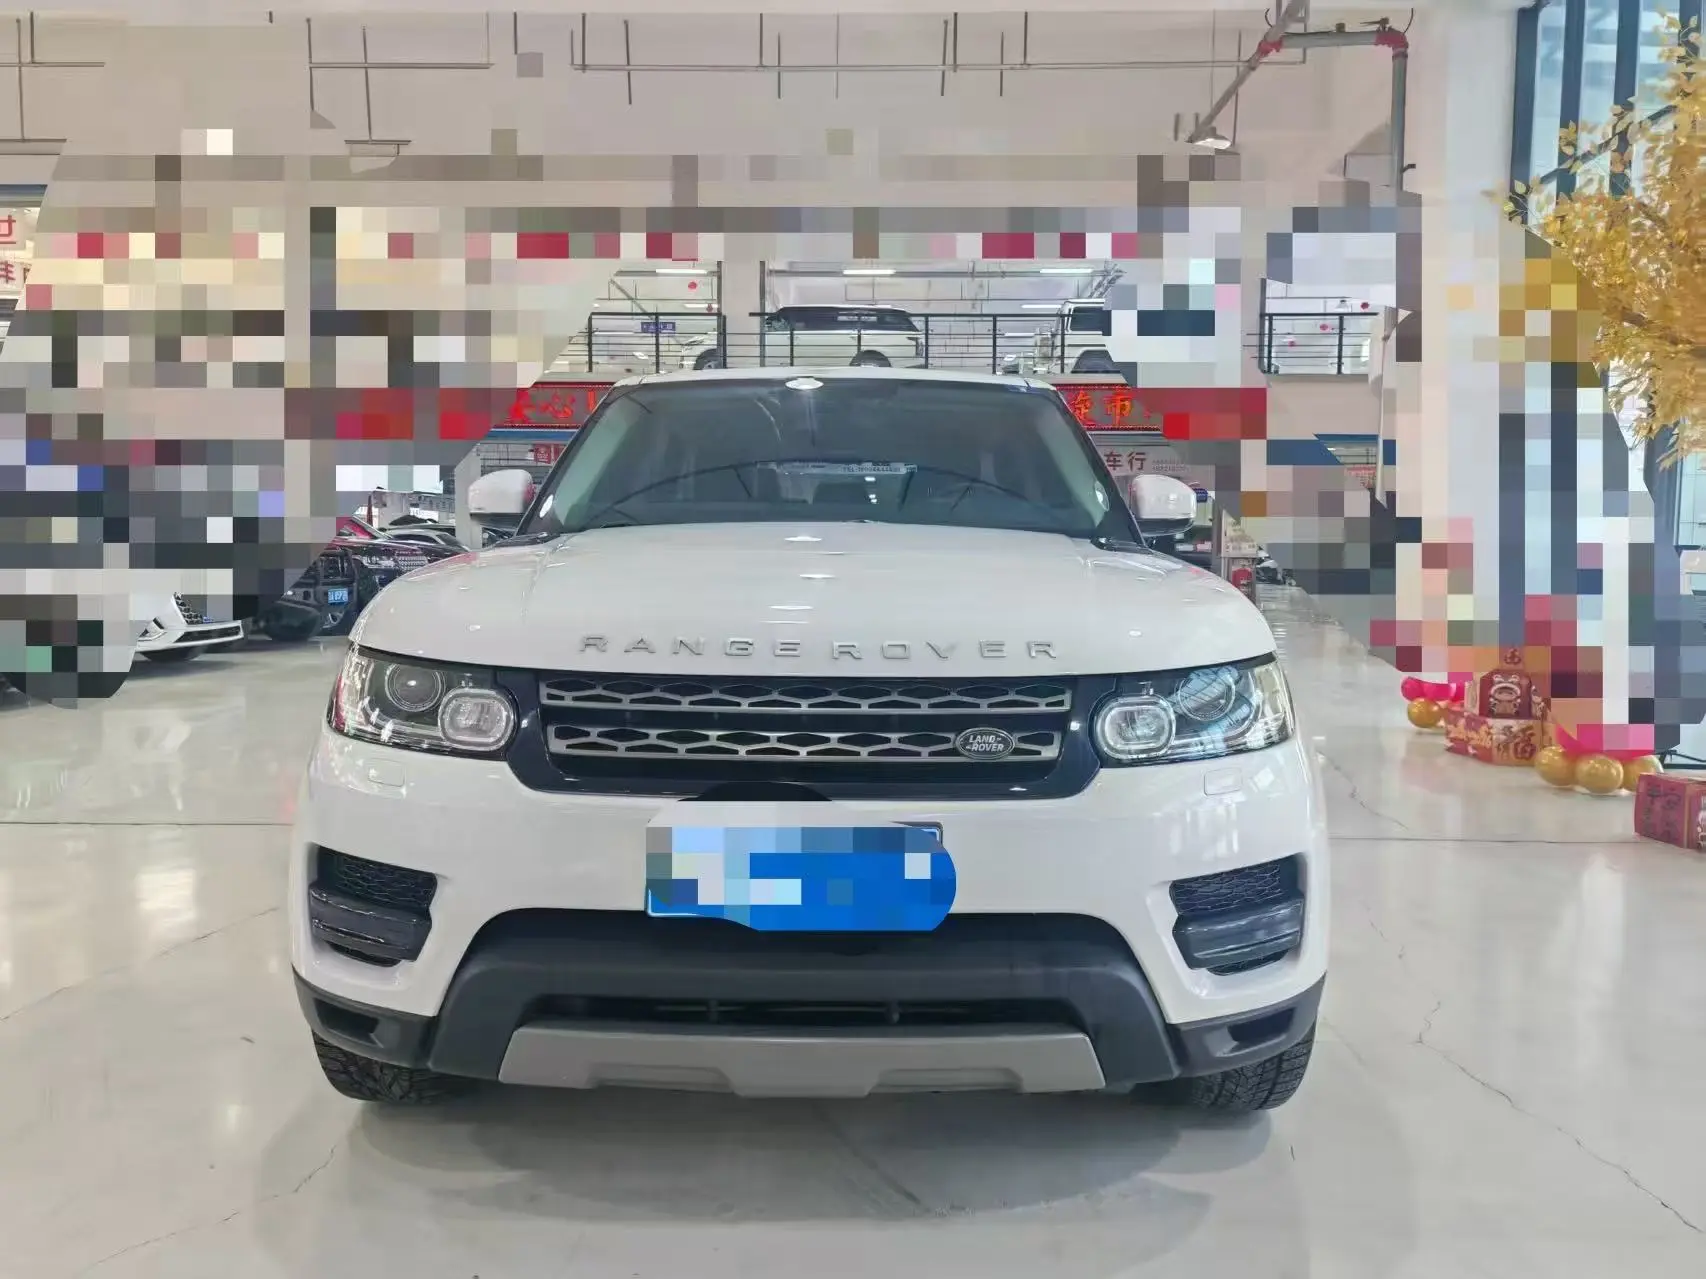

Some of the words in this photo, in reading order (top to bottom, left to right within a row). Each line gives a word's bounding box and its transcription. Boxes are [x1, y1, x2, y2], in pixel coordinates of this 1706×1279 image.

[1103, 450, 1147, 472] 车行
[579, 635, 801, 658] RANGE
[832, 639, 1057, 660] ROVER
[968, 734, 997, 743] LAND
[971, 743, 1004, 752] ROVER
